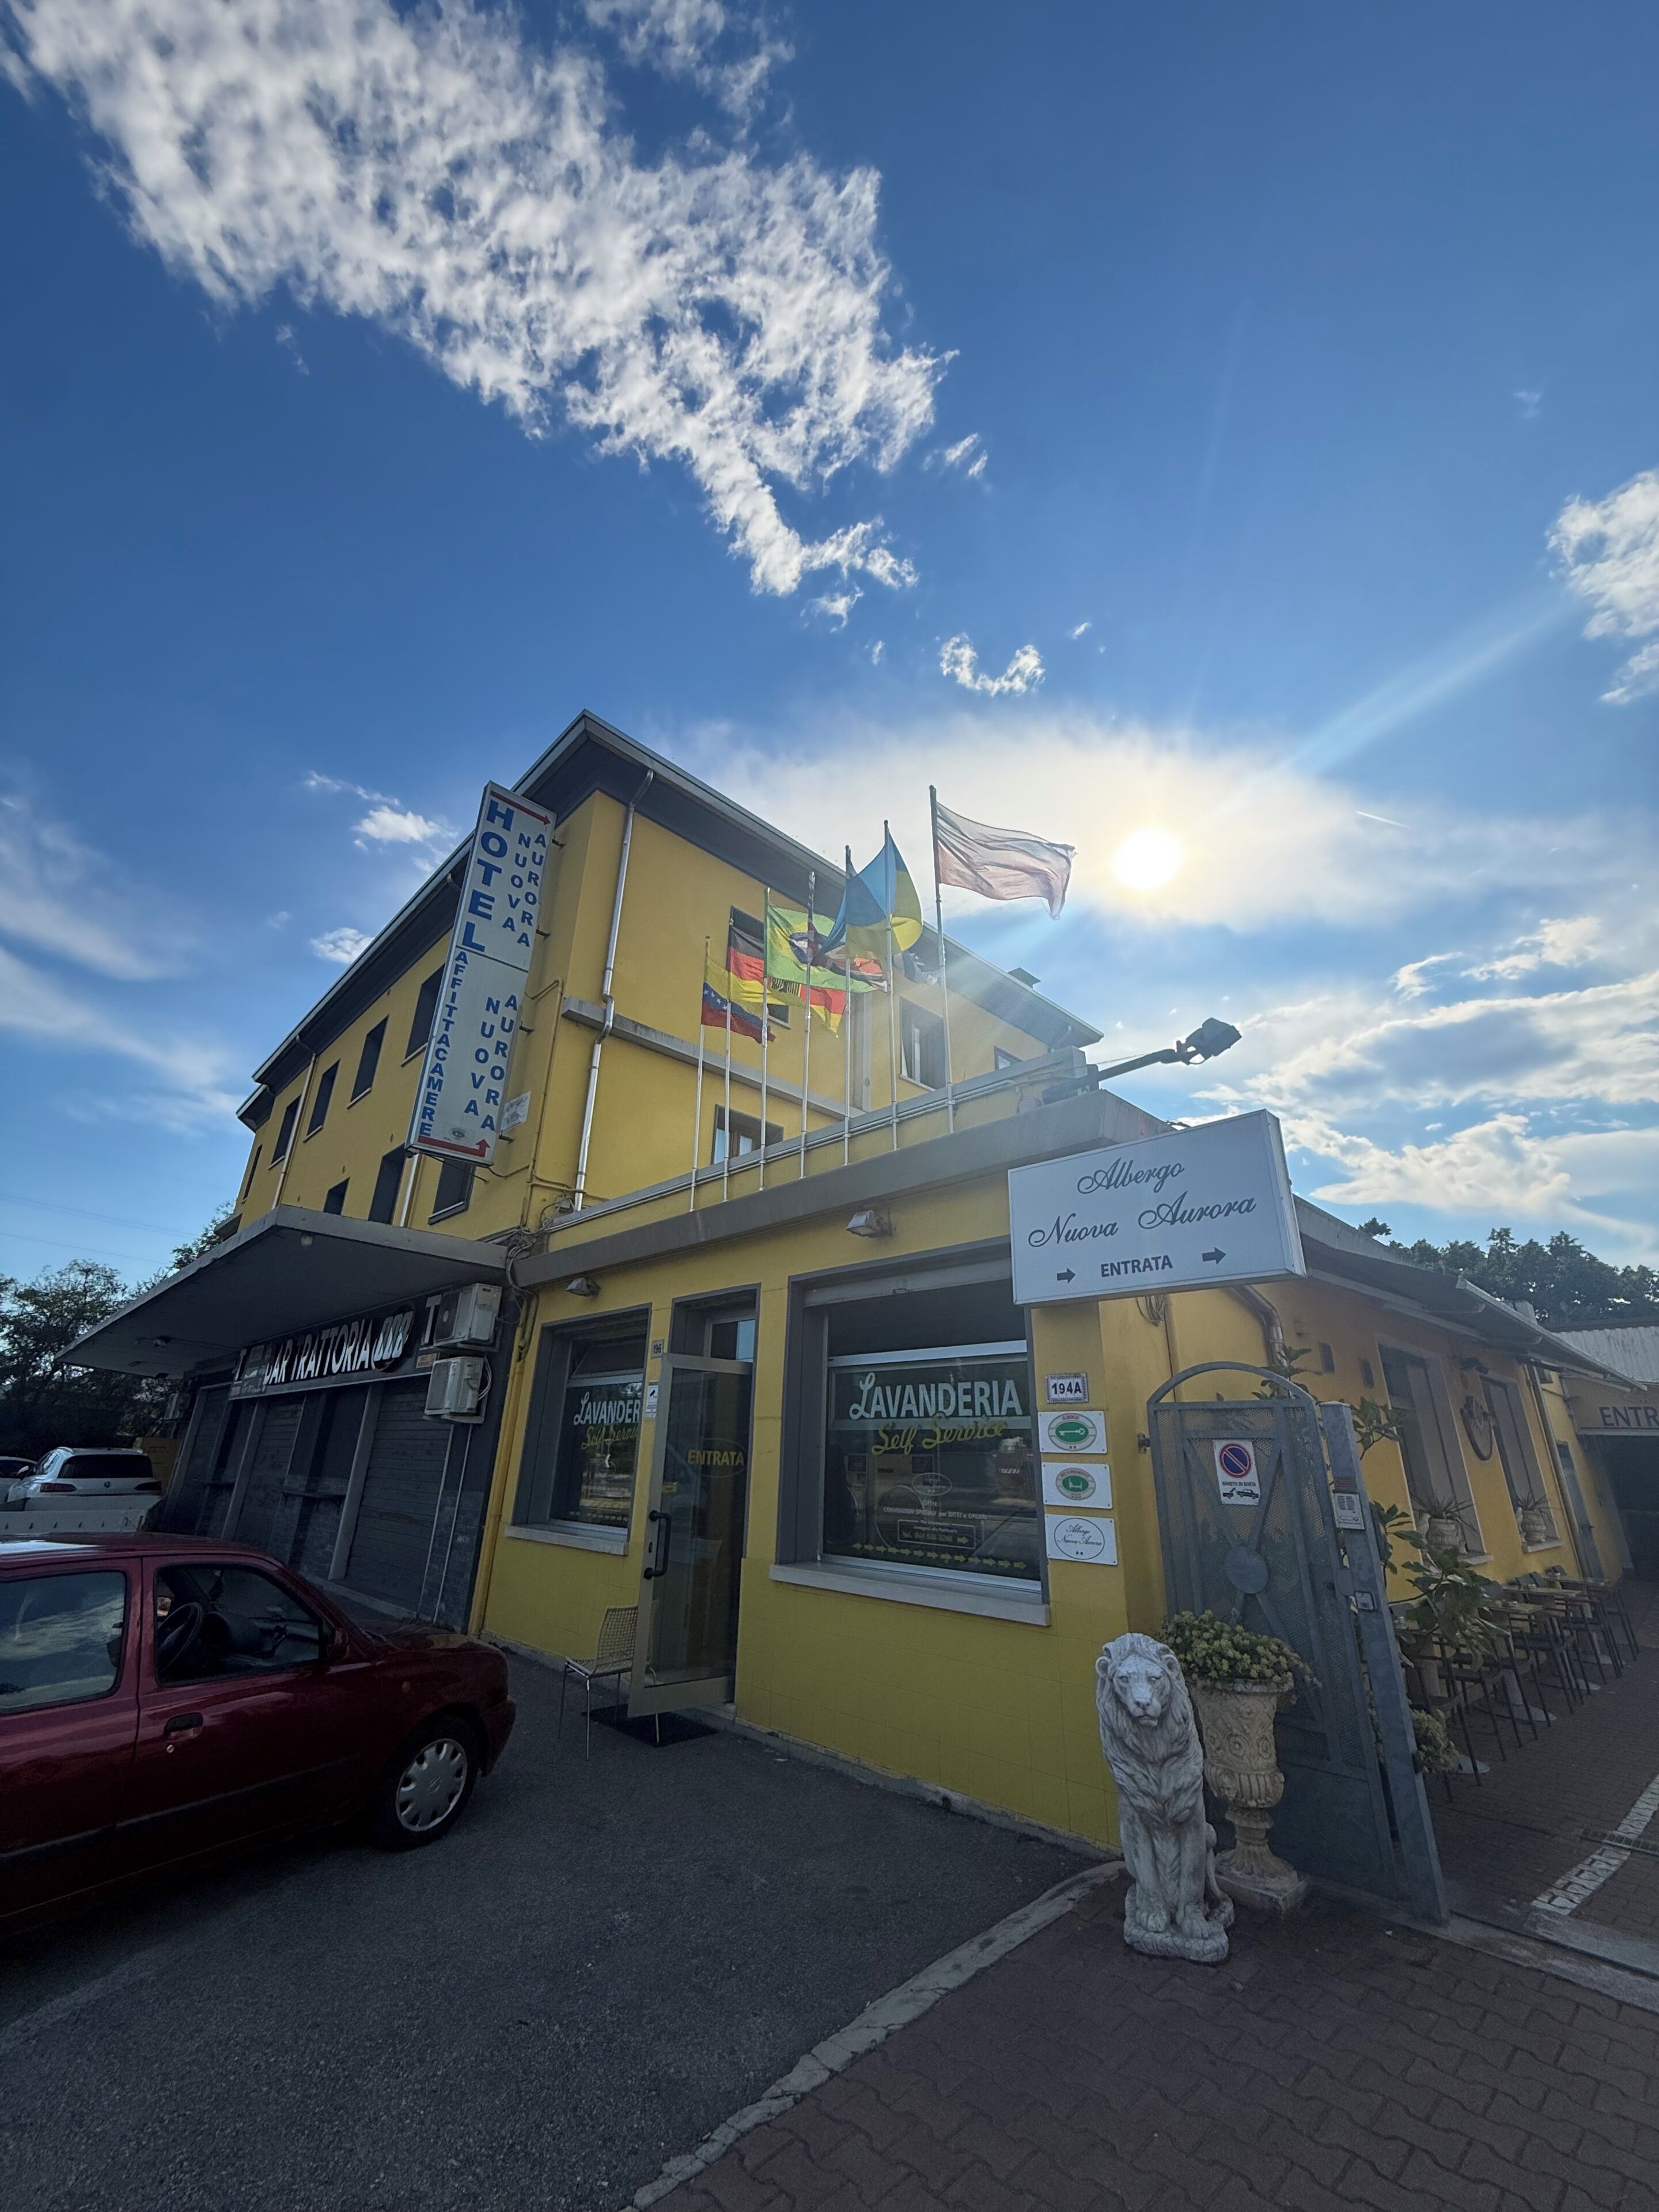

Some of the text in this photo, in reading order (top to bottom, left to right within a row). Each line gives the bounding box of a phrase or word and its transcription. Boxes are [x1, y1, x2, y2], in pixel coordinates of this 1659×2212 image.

[461, 799, 515, 954] HOTEL
[503, 831, 531, 932] NUOVA
[517, 832, 547, 948] AURORA
[419, 951, 468, 1137] AFFITTACAMERE
[464, 997, 501, 1116] NUOVA
[480, 994, 518, 1131] AURORA
[1077, 1157, 1184, 1194] Albergo
[1028, 1191, 1256, 1247] Nuova Aurora
[1101, 1255, 1173, 1278] ENTRATA
[290, 1318, 373, 1381] TRATTORIA
[653, 1343, 661, 1354] 196
[574, 1392, 641, 1425] LAVANDER
[849, 1372, 1022, 1420] LAVANDERIA
[1052, 1382, 1082, 1395] 194A
[872, 1411, 1007, 1455] Self Service
[1599, 1407, 1659, 1427] ENTR
[688, 1449, 744, 1467] ENTRATA
[1057, 1534, 1102, 1546] Nuova Aurora
[1066, 1524, 1090, 1535] Albergo
